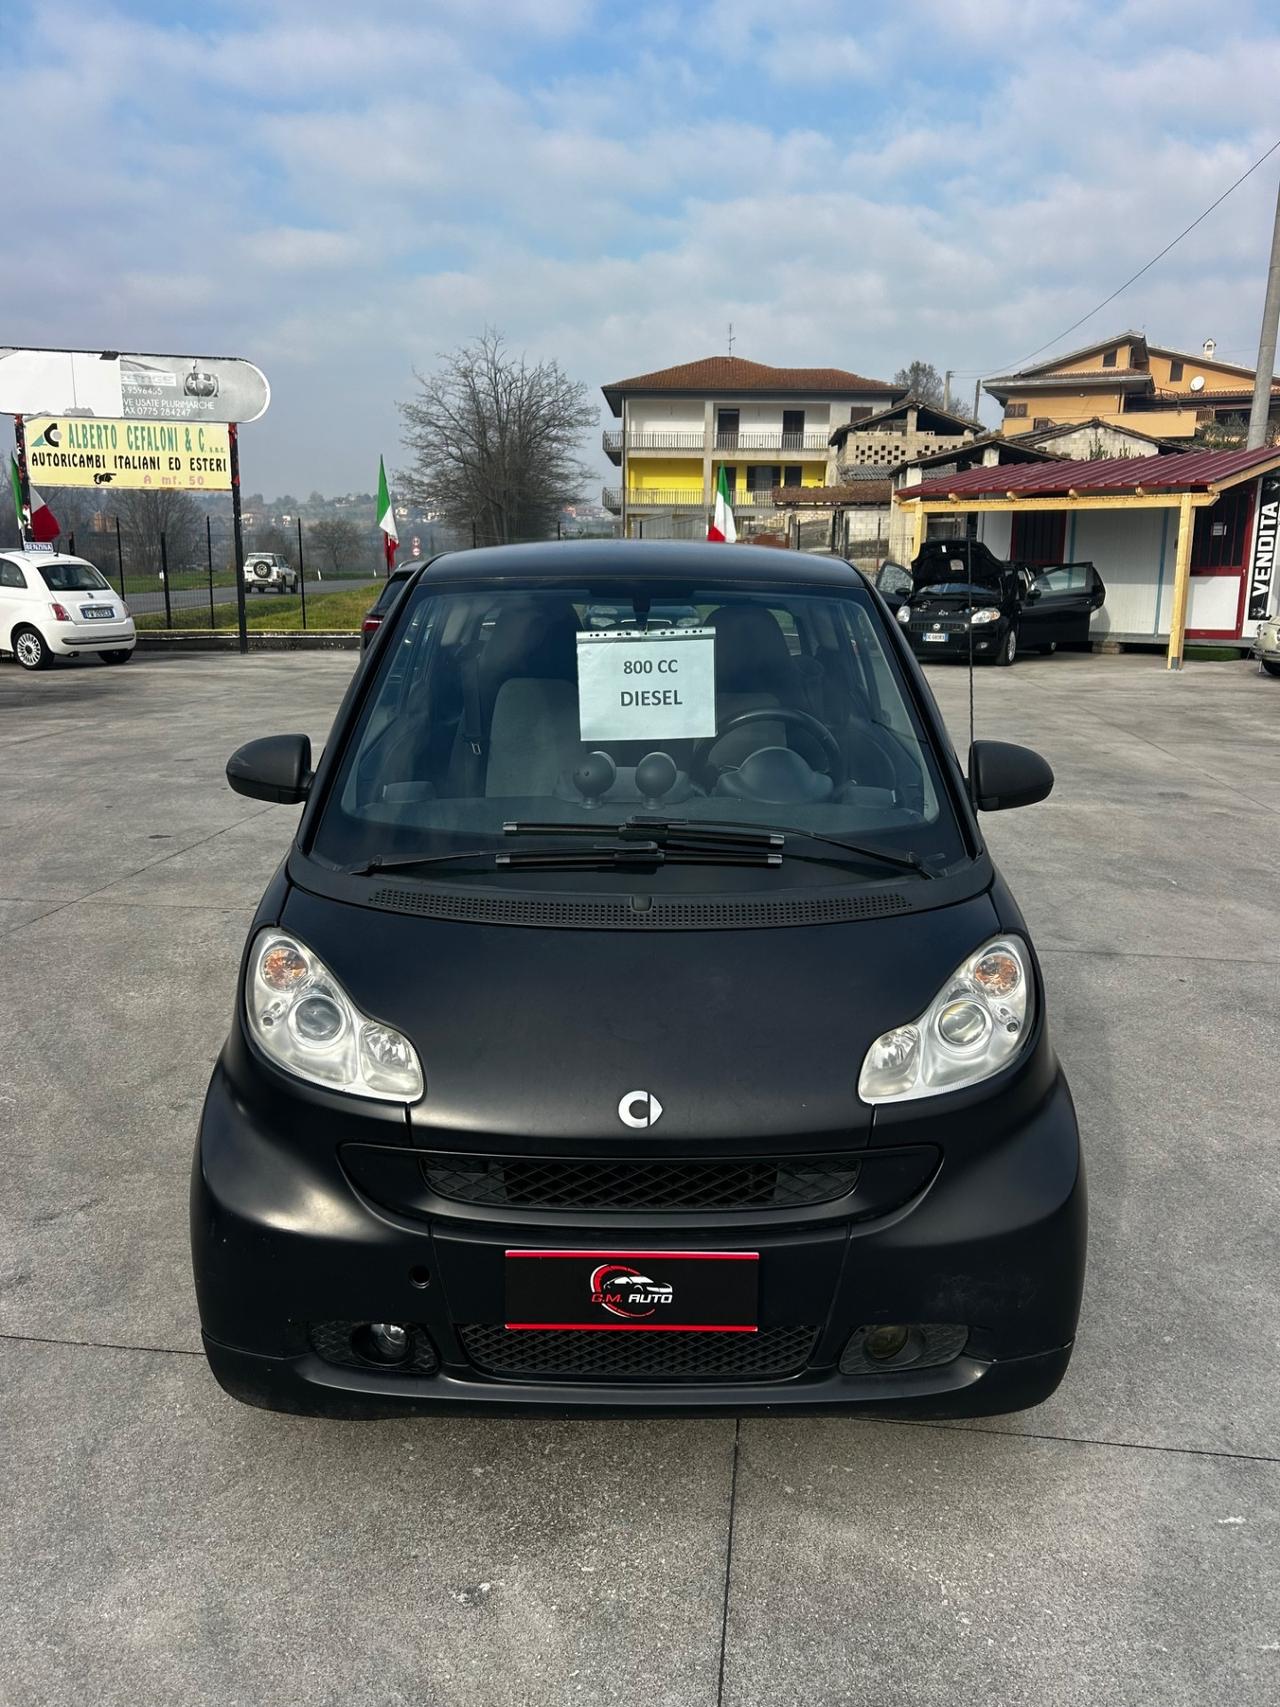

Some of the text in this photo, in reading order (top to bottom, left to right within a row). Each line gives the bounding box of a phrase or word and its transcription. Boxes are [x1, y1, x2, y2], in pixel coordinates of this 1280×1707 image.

[136, 398, 160, 408] USATE
[161, 400, 215, 410] PLURIMARCHE
[137, 406, 158, 416] 0775
[160, 408, 191, 417] 284247
[68, 423, 118, 450] ALBERTO
[127, 425, 178, 453] CEFALONI
[185, 427, 193, 453] &
[31, 452, 227, 472] AUTORICAMBI ITALIANI ED ESTERI
[143, 475, 151, 485] A
[189, 476, 205, 486] 50
[1252, 501, 1279, 597] VENDITA
[623, 659, 678, 675] 800 CC
[620, 690, 683, 707] DIESEL
[591, 1293, 673, 1304] G.M. AUTO
